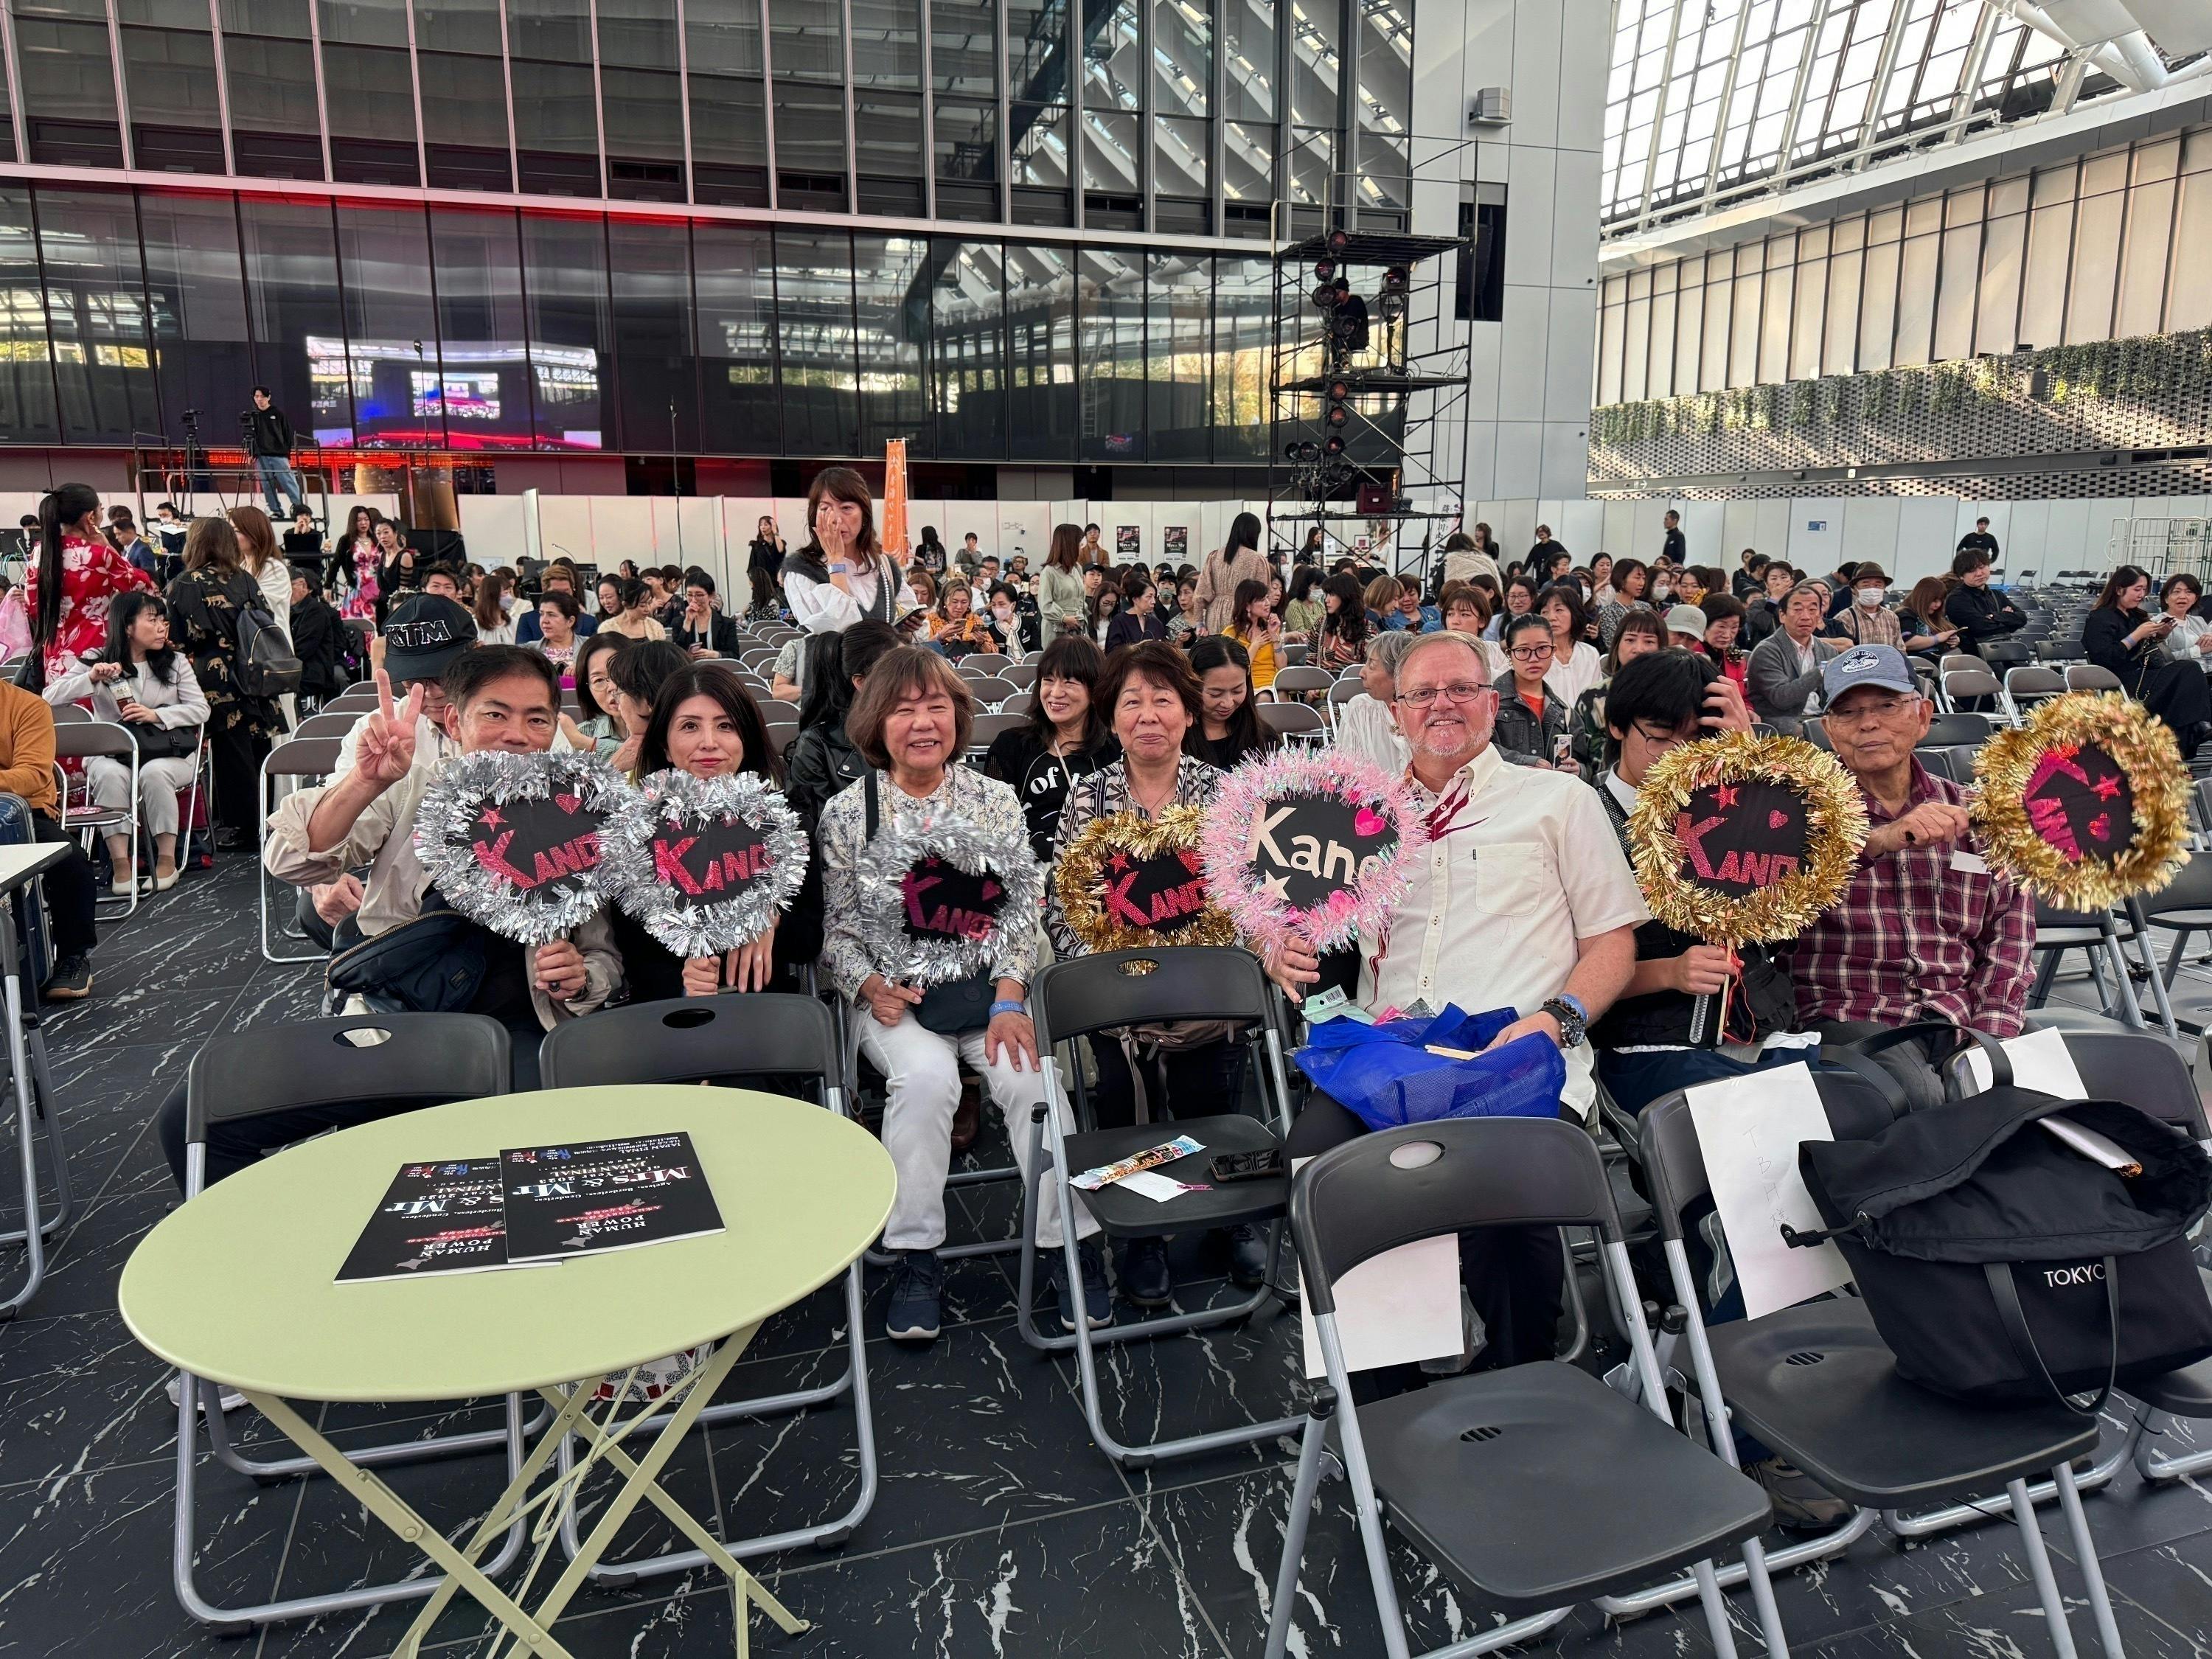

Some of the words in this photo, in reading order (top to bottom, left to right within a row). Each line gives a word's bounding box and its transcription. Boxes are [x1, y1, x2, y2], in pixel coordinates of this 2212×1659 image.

[1030, 767, 1060, 794] of
[550, 1167, 597, 1178] FINAL
[600, 1161, 647, 1172] JAPAN
[612, 1166, 692, 1185] Mrs
[512, 1181, 575, 1197] Mr
[581, 1178, 605, 1187] &
[435, 1185, 482, 1194] FINAL
[384, 1199, 452, 1215] Mr
[457, 1197, 481, 1206] &
[577, 1214, 644, 1229] POWER
[579, 1221, 647, 1236] HUMAN
[420, 1245, 491, 1257] HUMAN
[424, 1238, 493, 1251] POWER
